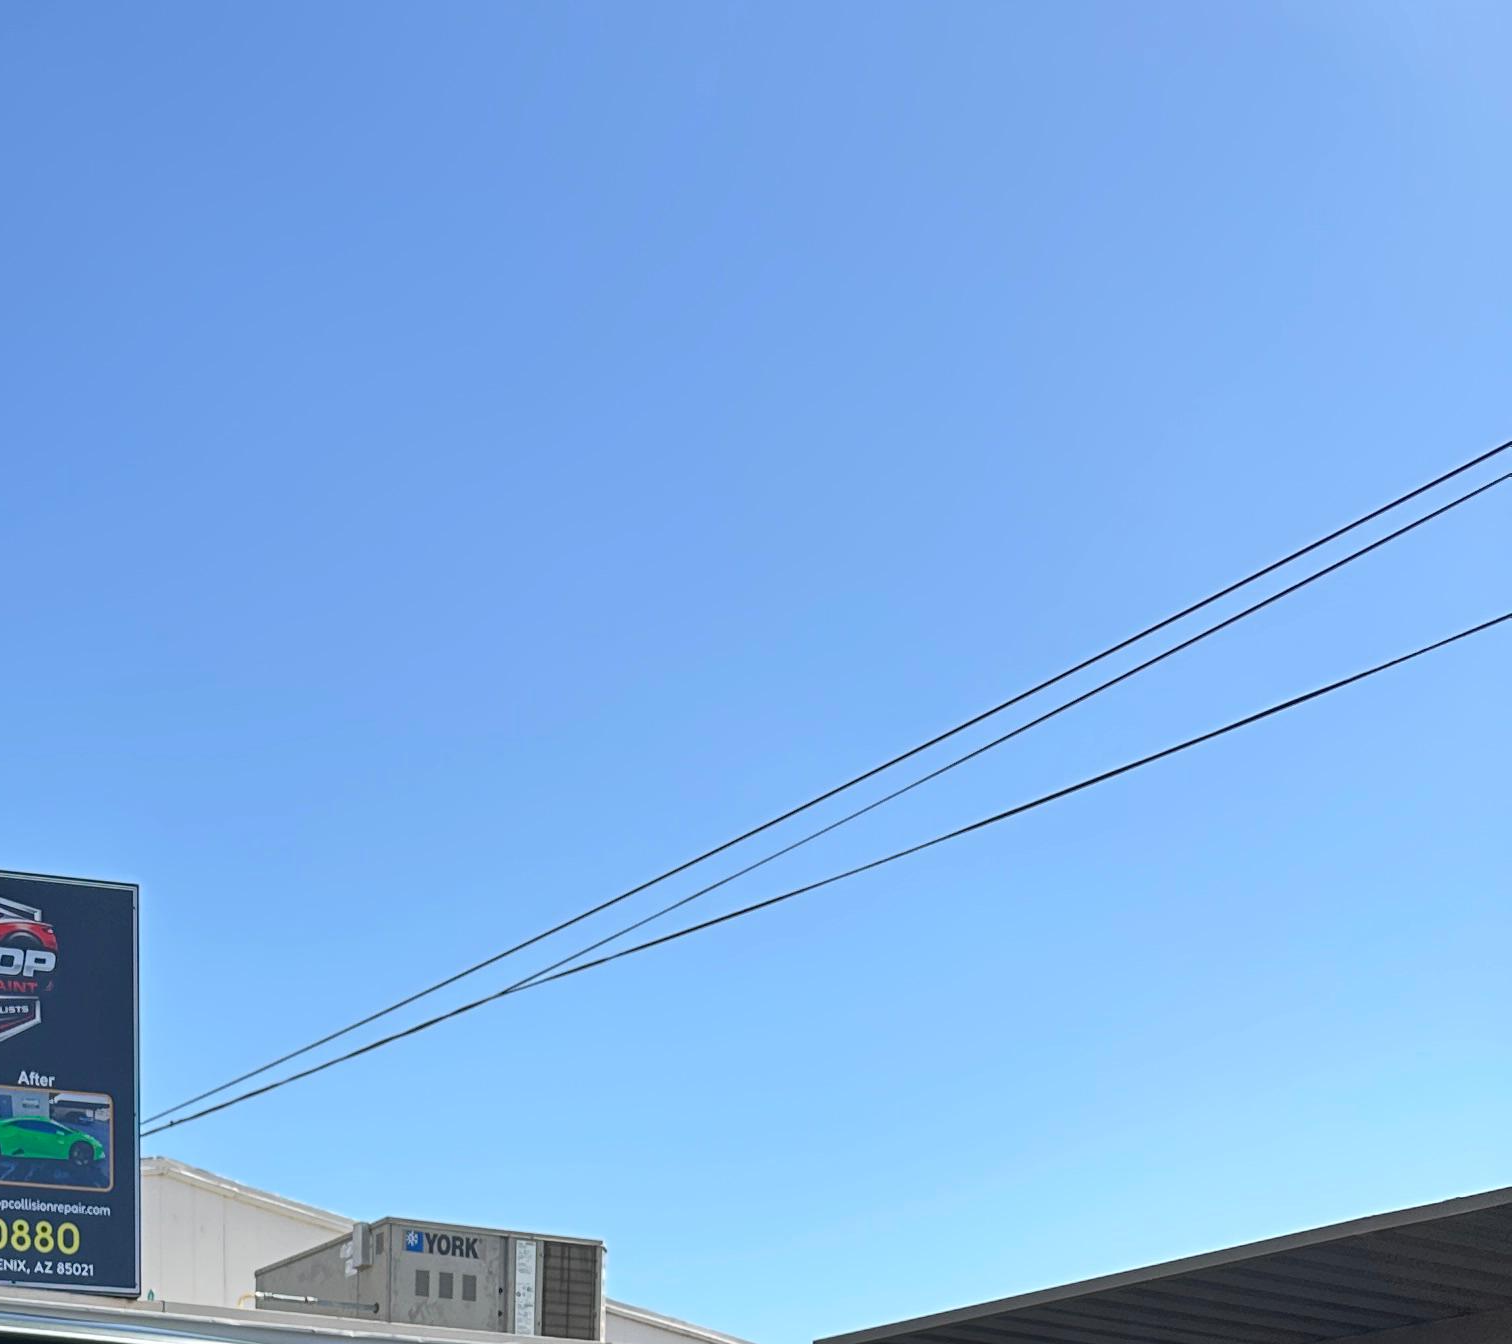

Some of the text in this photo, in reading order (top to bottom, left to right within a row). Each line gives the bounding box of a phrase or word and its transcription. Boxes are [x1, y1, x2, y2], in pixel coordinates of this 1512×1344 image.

[18, 1070, 55, 1088] After
[425, 1232, 479, 1259] YORK
[34, 1261, 53, 1274] AZ
[57, 1261, 94, 1277] 85021
